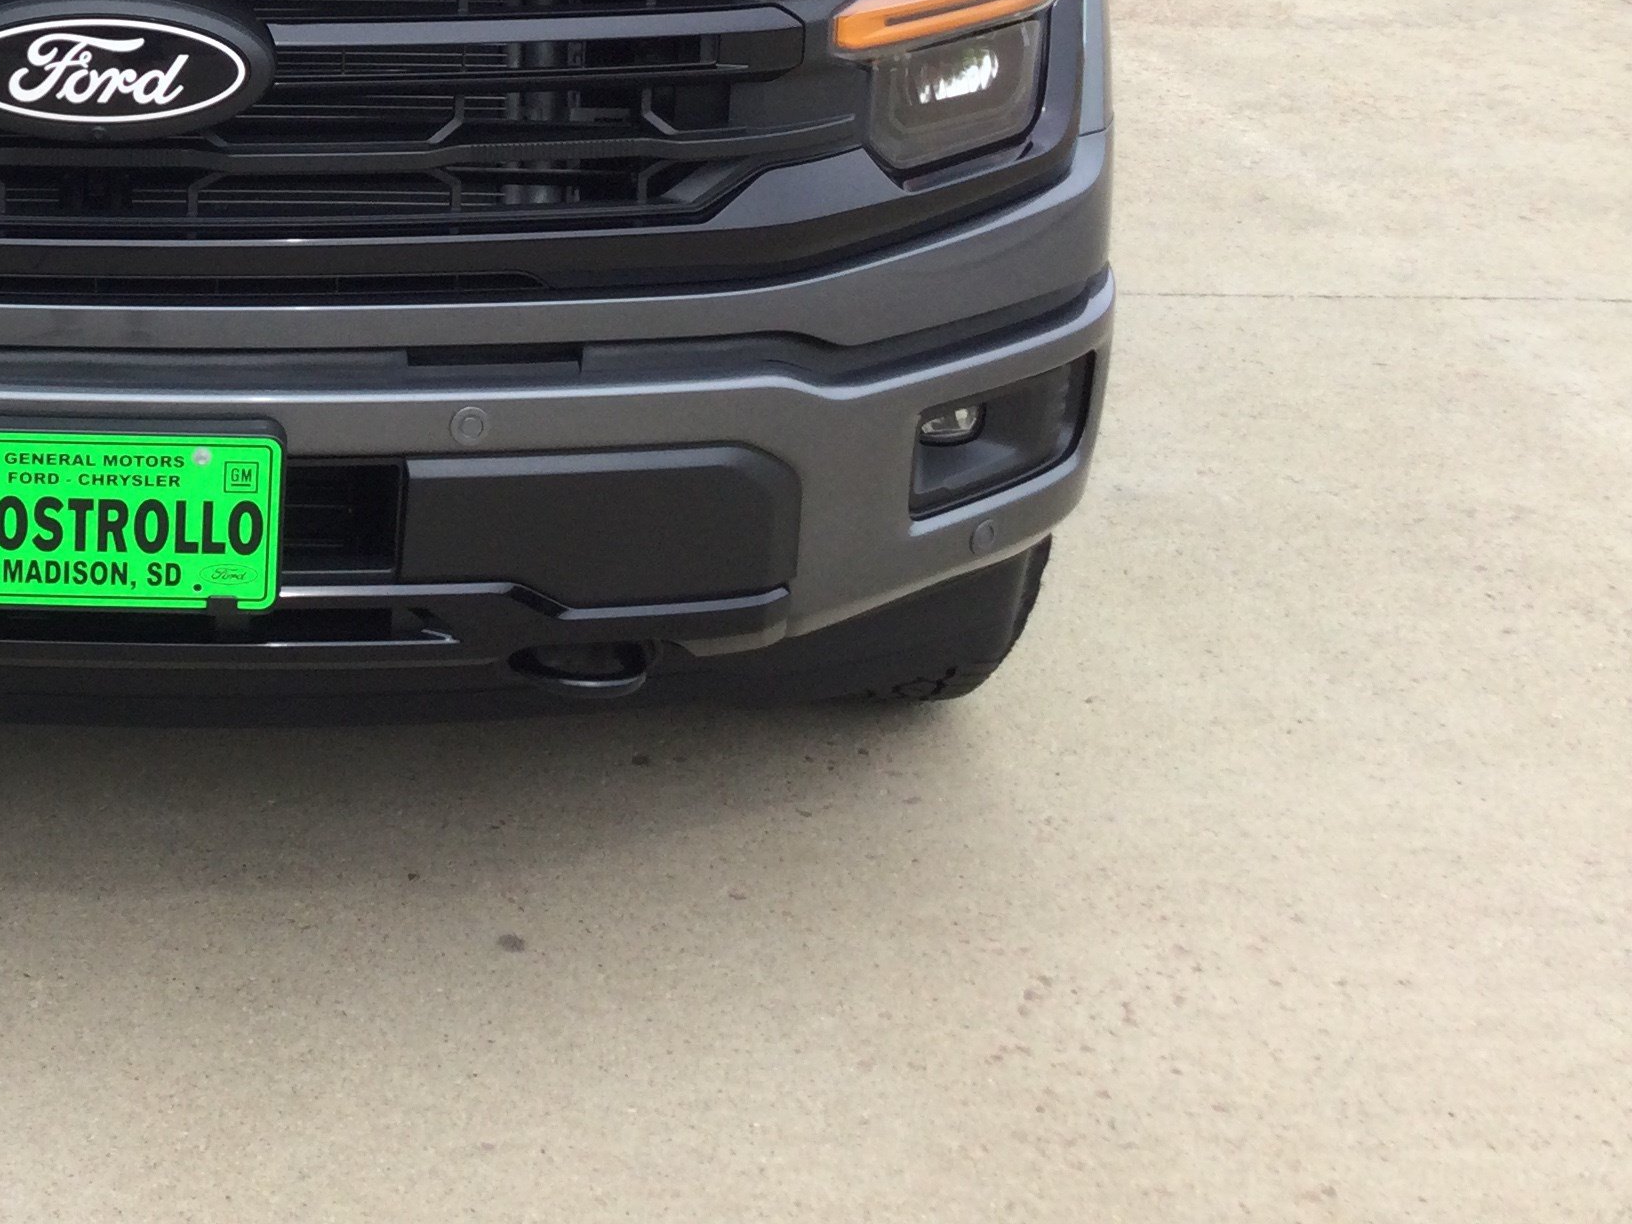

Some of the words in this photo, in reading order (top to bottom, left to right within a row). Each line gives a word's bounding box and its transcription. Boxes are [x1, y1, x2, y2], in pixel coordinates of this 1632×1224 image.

[8, 32, 190, 106] Ford
[4, 451, 96, 467] GENERAL
[103, 454, 185, 469] MOTORS
[8, 471, 59, 485] FORD
[77, 472, 181, 487] CHRYSLER
[230, 468, 253, 483] GM
[2, 558, 137, 590] MADISON,
[146, 561, 182, 587] SD
[210, 567, 246, 580] Ford
